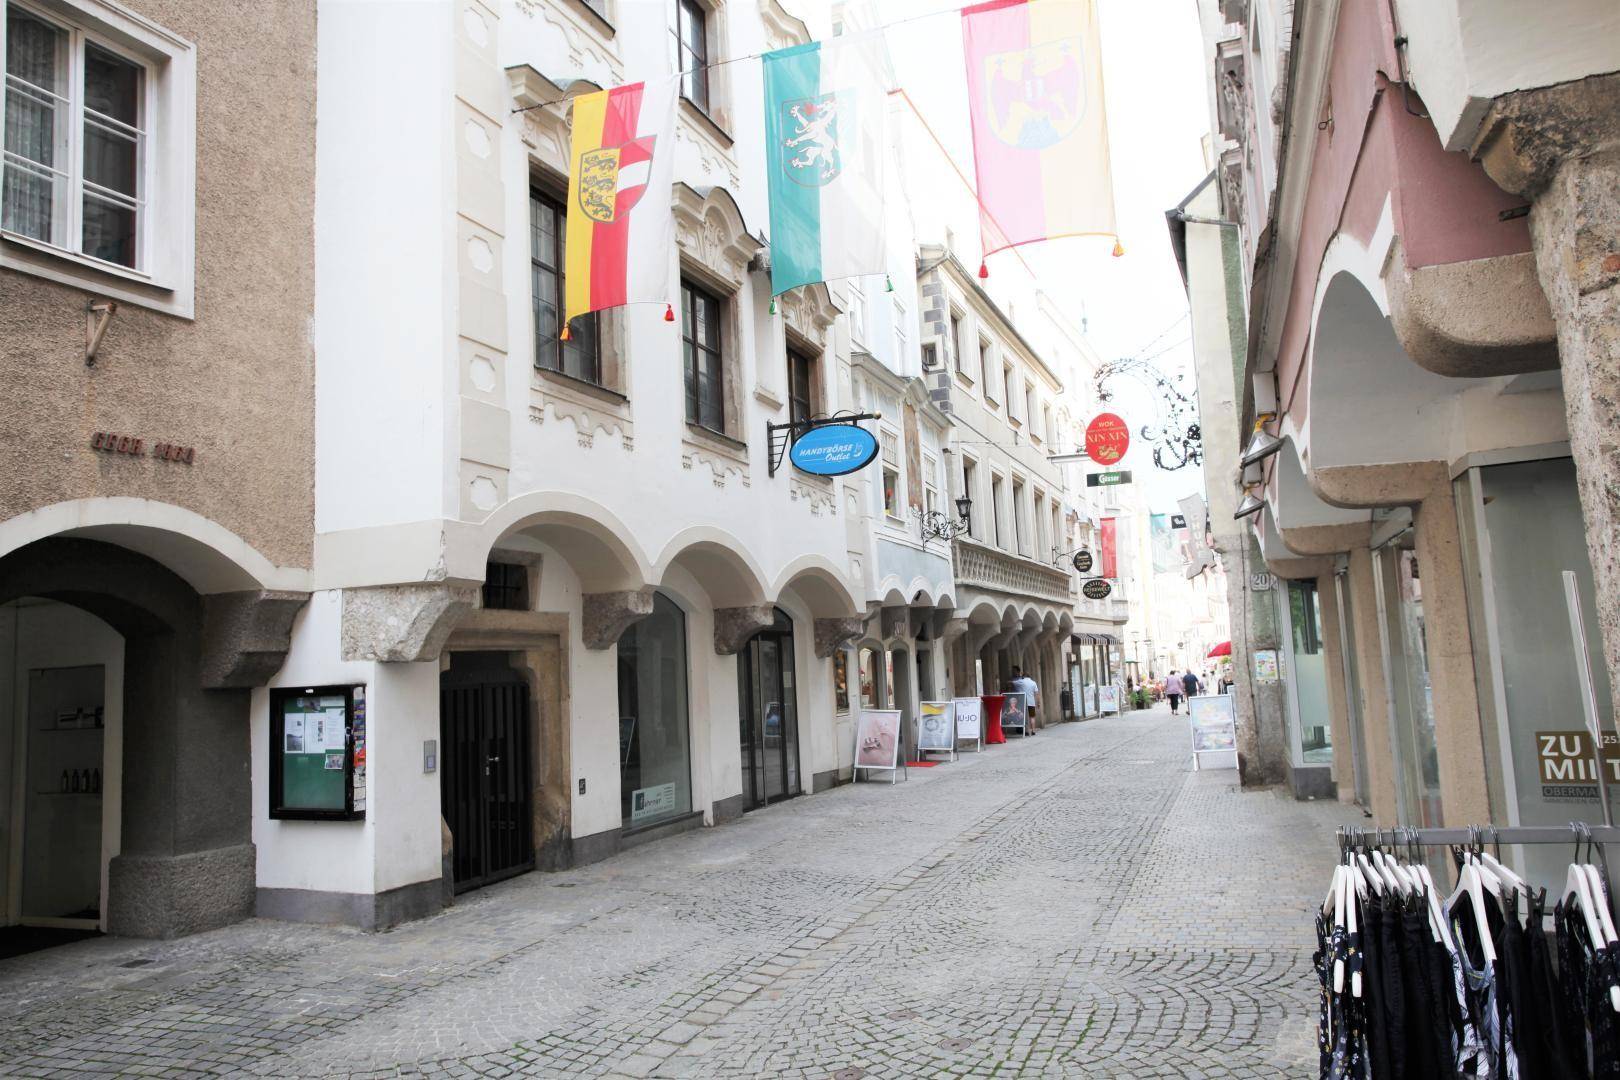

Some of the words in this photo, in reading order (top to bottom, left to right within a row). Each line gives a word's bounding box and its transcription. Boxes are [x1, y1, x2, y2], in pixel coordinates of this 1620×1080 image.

[1087, 432, 1106, 443] XIN
[1109, 431, 1127, 441] XIN
[799, 443, 853, 457] HANDYBÖRSE
[825, 452, 850, 462] Outlet
[1254, 574, 1268, 586] 20
[1540, 735, 1581, 757] ZU
